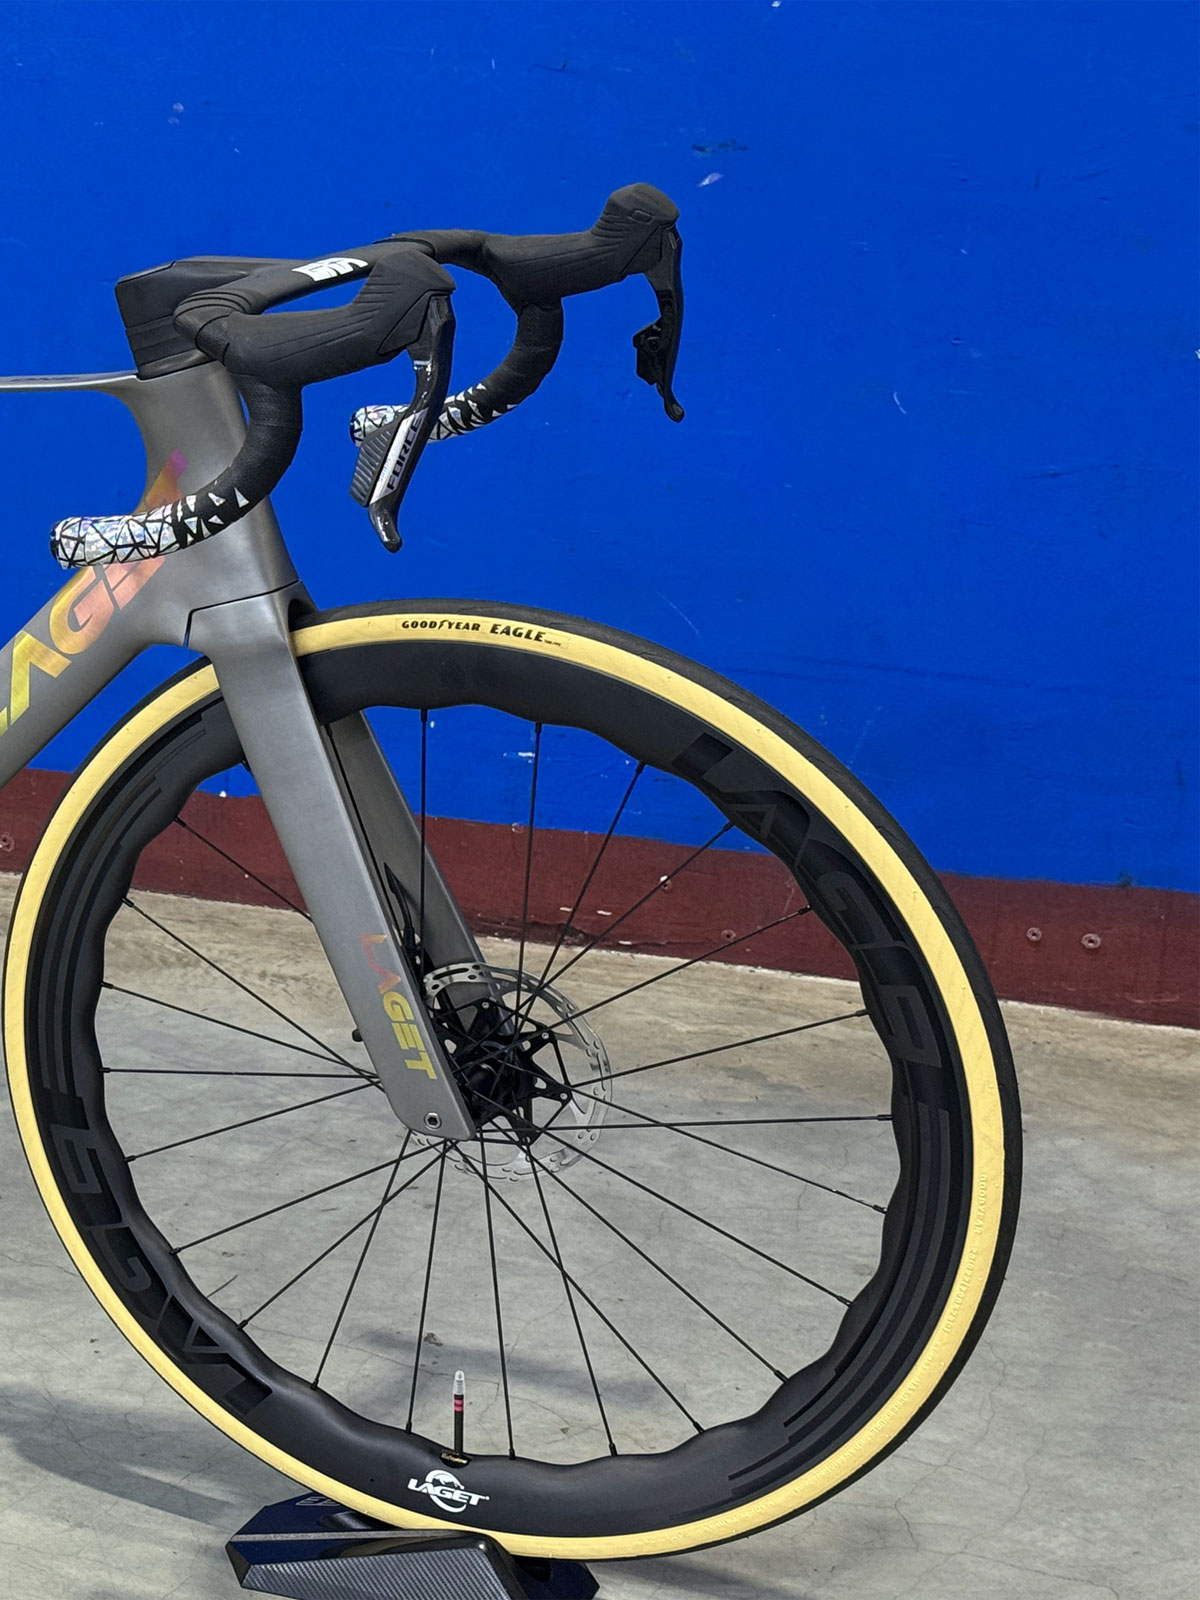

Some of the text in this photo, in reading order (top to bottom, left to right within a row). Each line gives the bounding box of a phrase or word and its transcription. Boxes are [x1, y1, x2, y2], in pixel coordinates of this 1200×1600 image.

[386, 413, 426, 490] FORCE
[489, 623, 547, 643] EAGLE
[360, 933, 438, 1080] LAGET
[407, 1478, 486, 1506] LAGET
